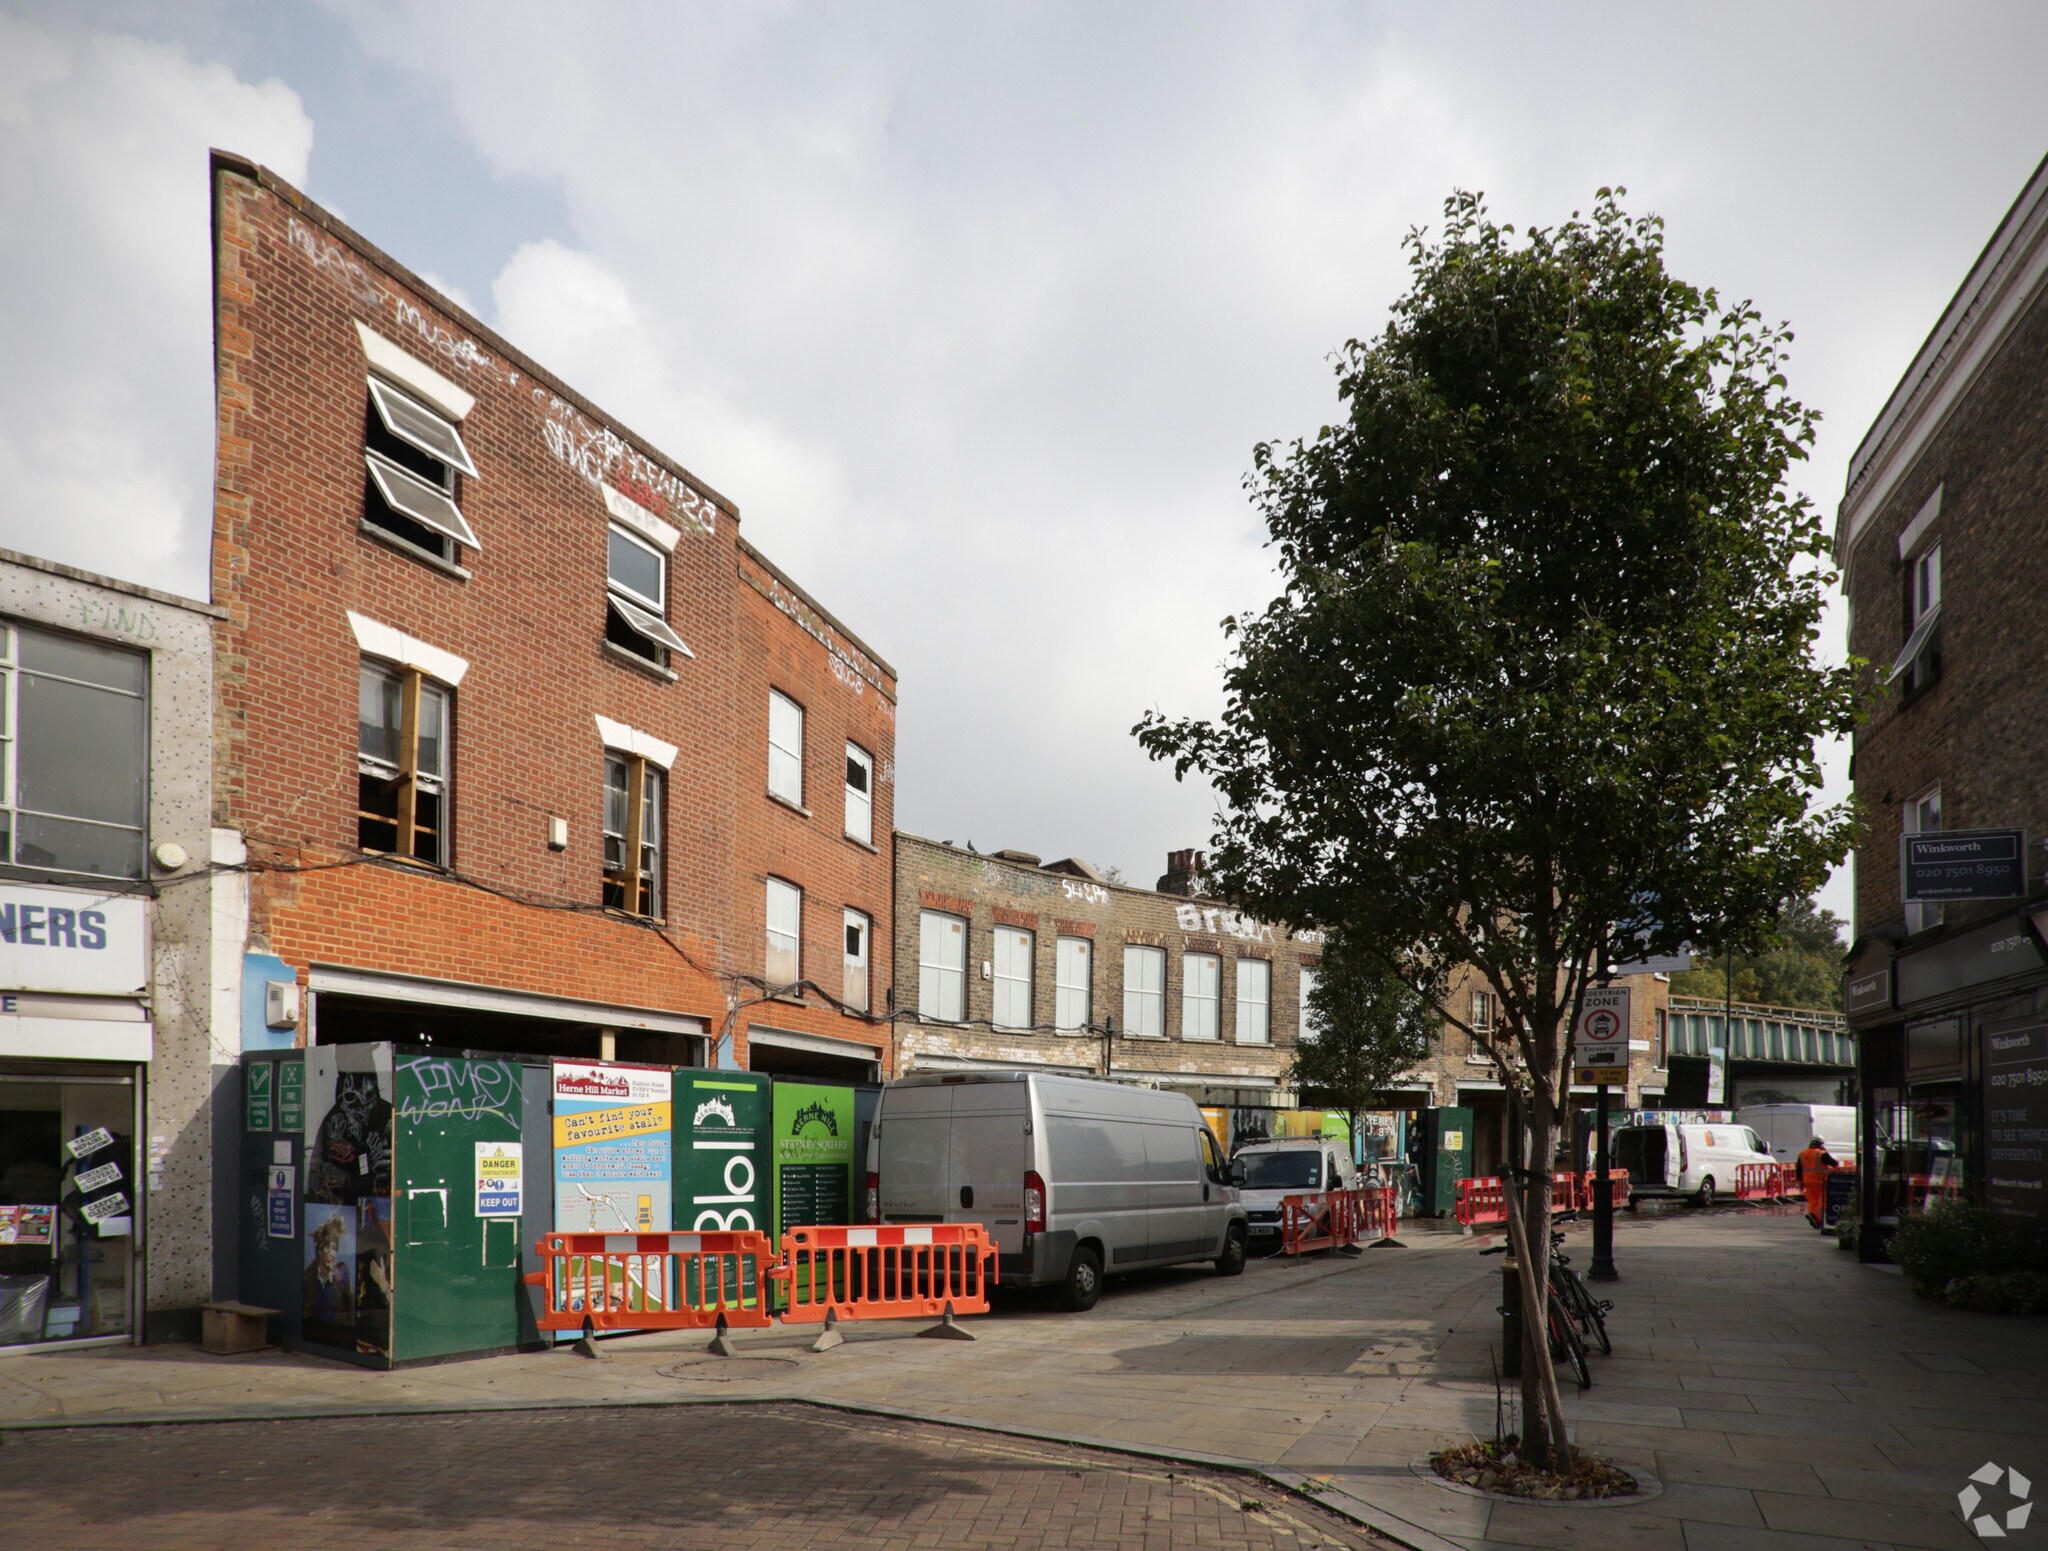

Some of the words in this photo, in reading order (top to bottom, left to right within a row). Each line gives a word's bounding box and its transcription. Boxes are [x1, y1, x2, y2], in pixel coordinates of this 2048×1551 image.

[1916, 842, 1981, 854] Winkworth
[1916, 868, 1942, 878] 020
[1944, 867, 1973, 878] 7501
[1976, 864, 2011, 877] 8950
[1917, 886, 1972, 895] winkworth.co.uk
[1852, 979, 1876, 997] Winkworth
[2, 996, 17, 1012] E
[1586, 997, 1619, 1007] ZONE
[1992, 1033, 2030, 1050] Winkworth
[1991, 1074, 2006, 1086] 020
[559, 1084, 584, 1094] Herne
[585, 1085, 599, 1094] Hill
[601, 1086, 628, 1097] Market
[565, 1115, 594, 1128] Can't
[600, 1110, 623, 1123] find
[629, 1107, 653, 1121] your
[697, 1107, 718, 1122] HERNE
[719, 1109, 733, 1122] HILL
[2007, 1108, 2027, 1122] TIME
[568, 1123, 625, 1141] favourite
[630, 1116, 663, 1131] stall?
[794, 1112, 819, 1133] HERNE
[821, 1114, 835, 1134] HILL
[1992, 1129, 2001, 1141] TO
[2003, 1129, 2016, 1141] SEE
[2017, 1128, 2048, 1141] THINGS
[818, 1140, 849, 1152] SQUARE
[483, 1160, 516, 1168] DANGER
[480, 1198, 501, 1207] KEEP
[502, 1198, 517, 1207] OUT
